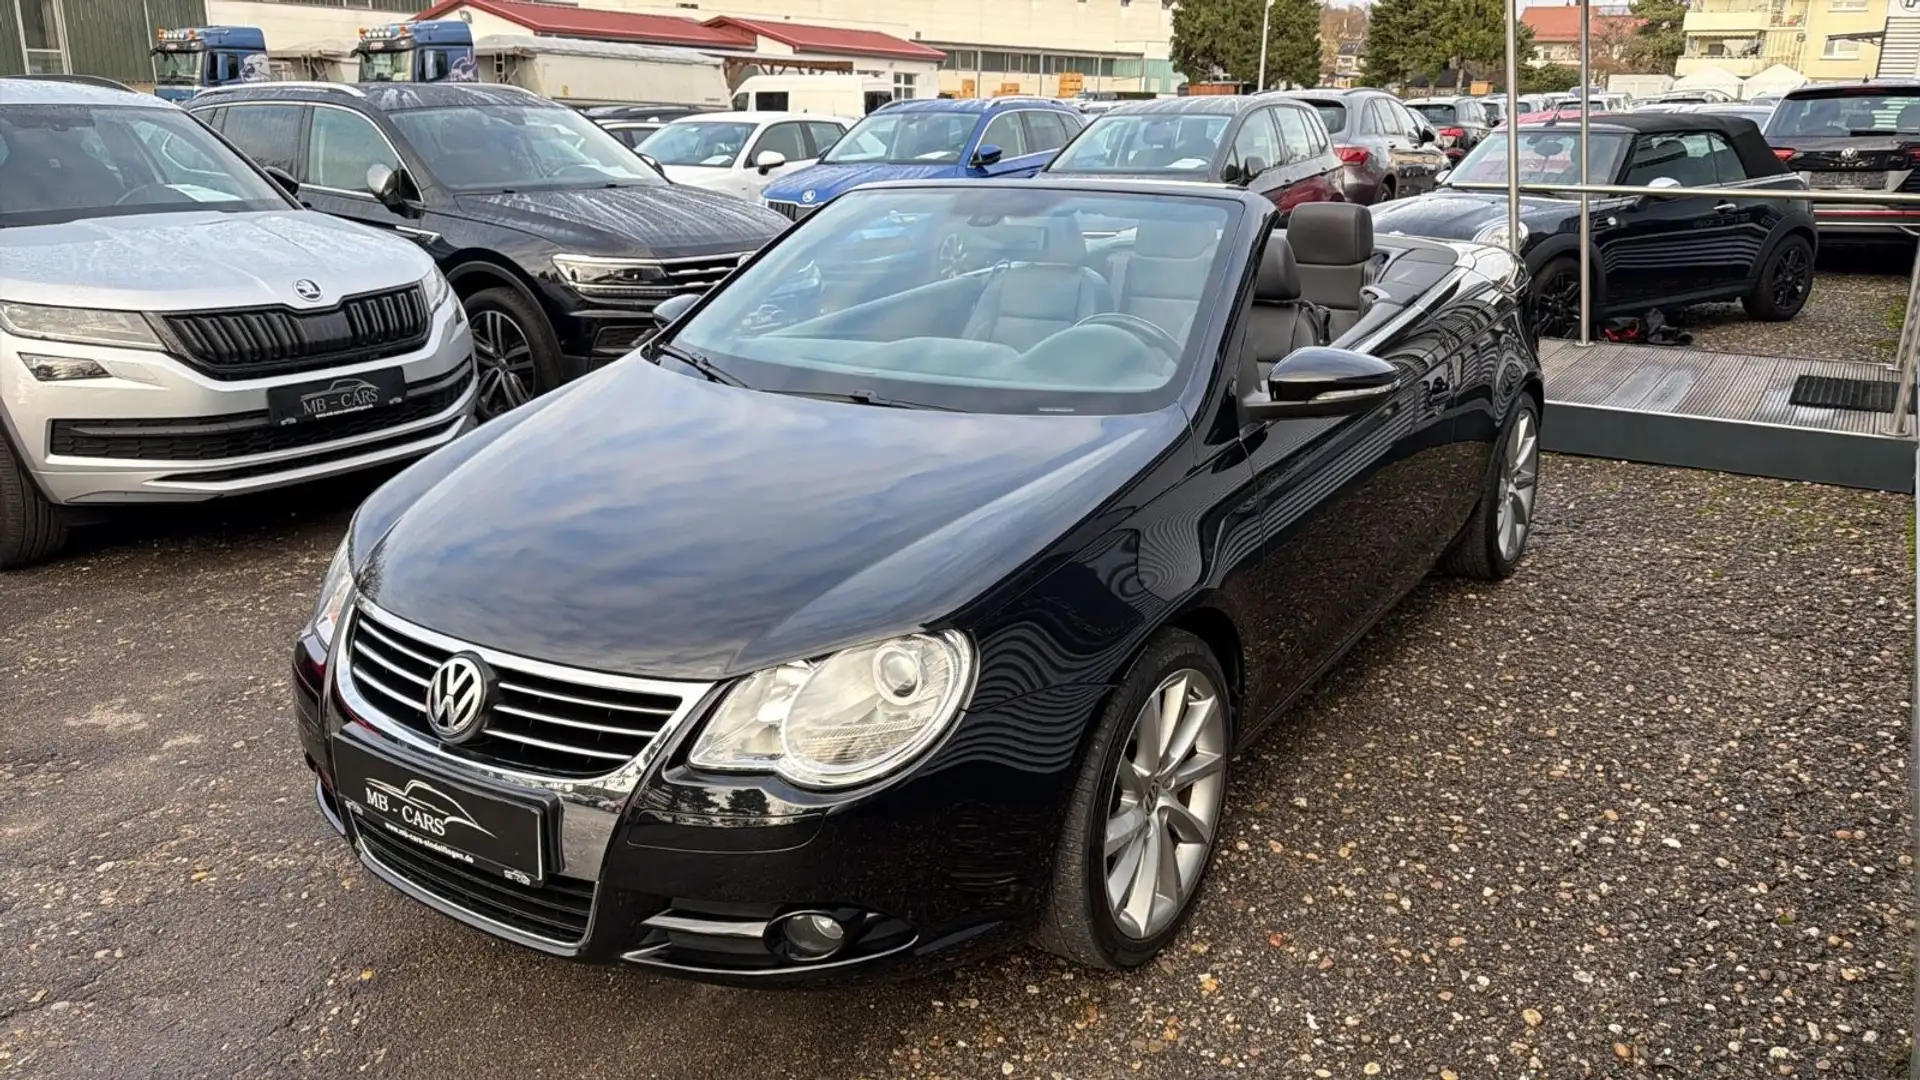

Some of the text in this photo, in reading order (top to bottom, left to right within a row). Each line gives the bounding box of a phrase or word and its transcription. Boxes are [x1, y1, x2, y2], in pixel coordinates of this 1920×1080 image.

[302, 397, 327, 416] MB
[341, 389, 379, 408] CARS
[365, 787, 389, 812] MB
[402, 804, 446, 837] CARS
